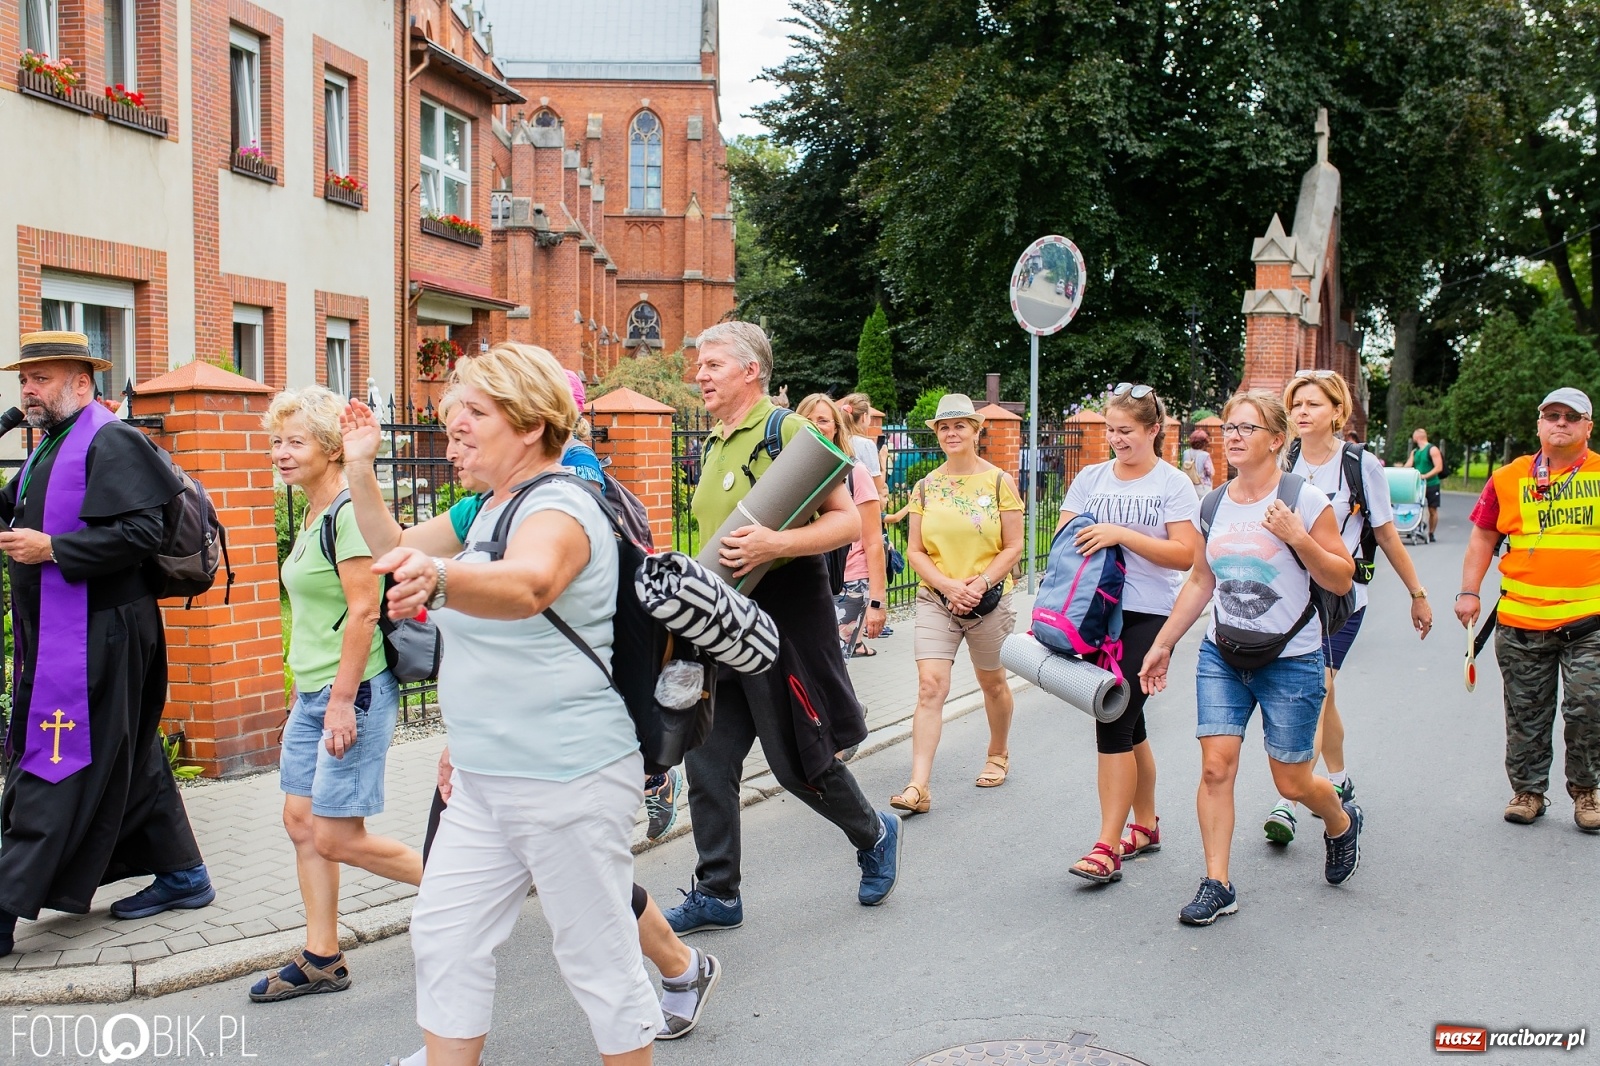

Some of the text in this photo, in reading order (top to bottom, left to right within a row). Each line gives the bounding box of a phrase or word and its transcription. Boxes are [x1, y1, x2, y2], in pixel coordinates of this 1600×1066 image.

[1523, 480, 1600, 503] KIOWANI
[1228, 521, 1263, 532] KISS
[1538, 505, 1593, 528] RUCHEM
